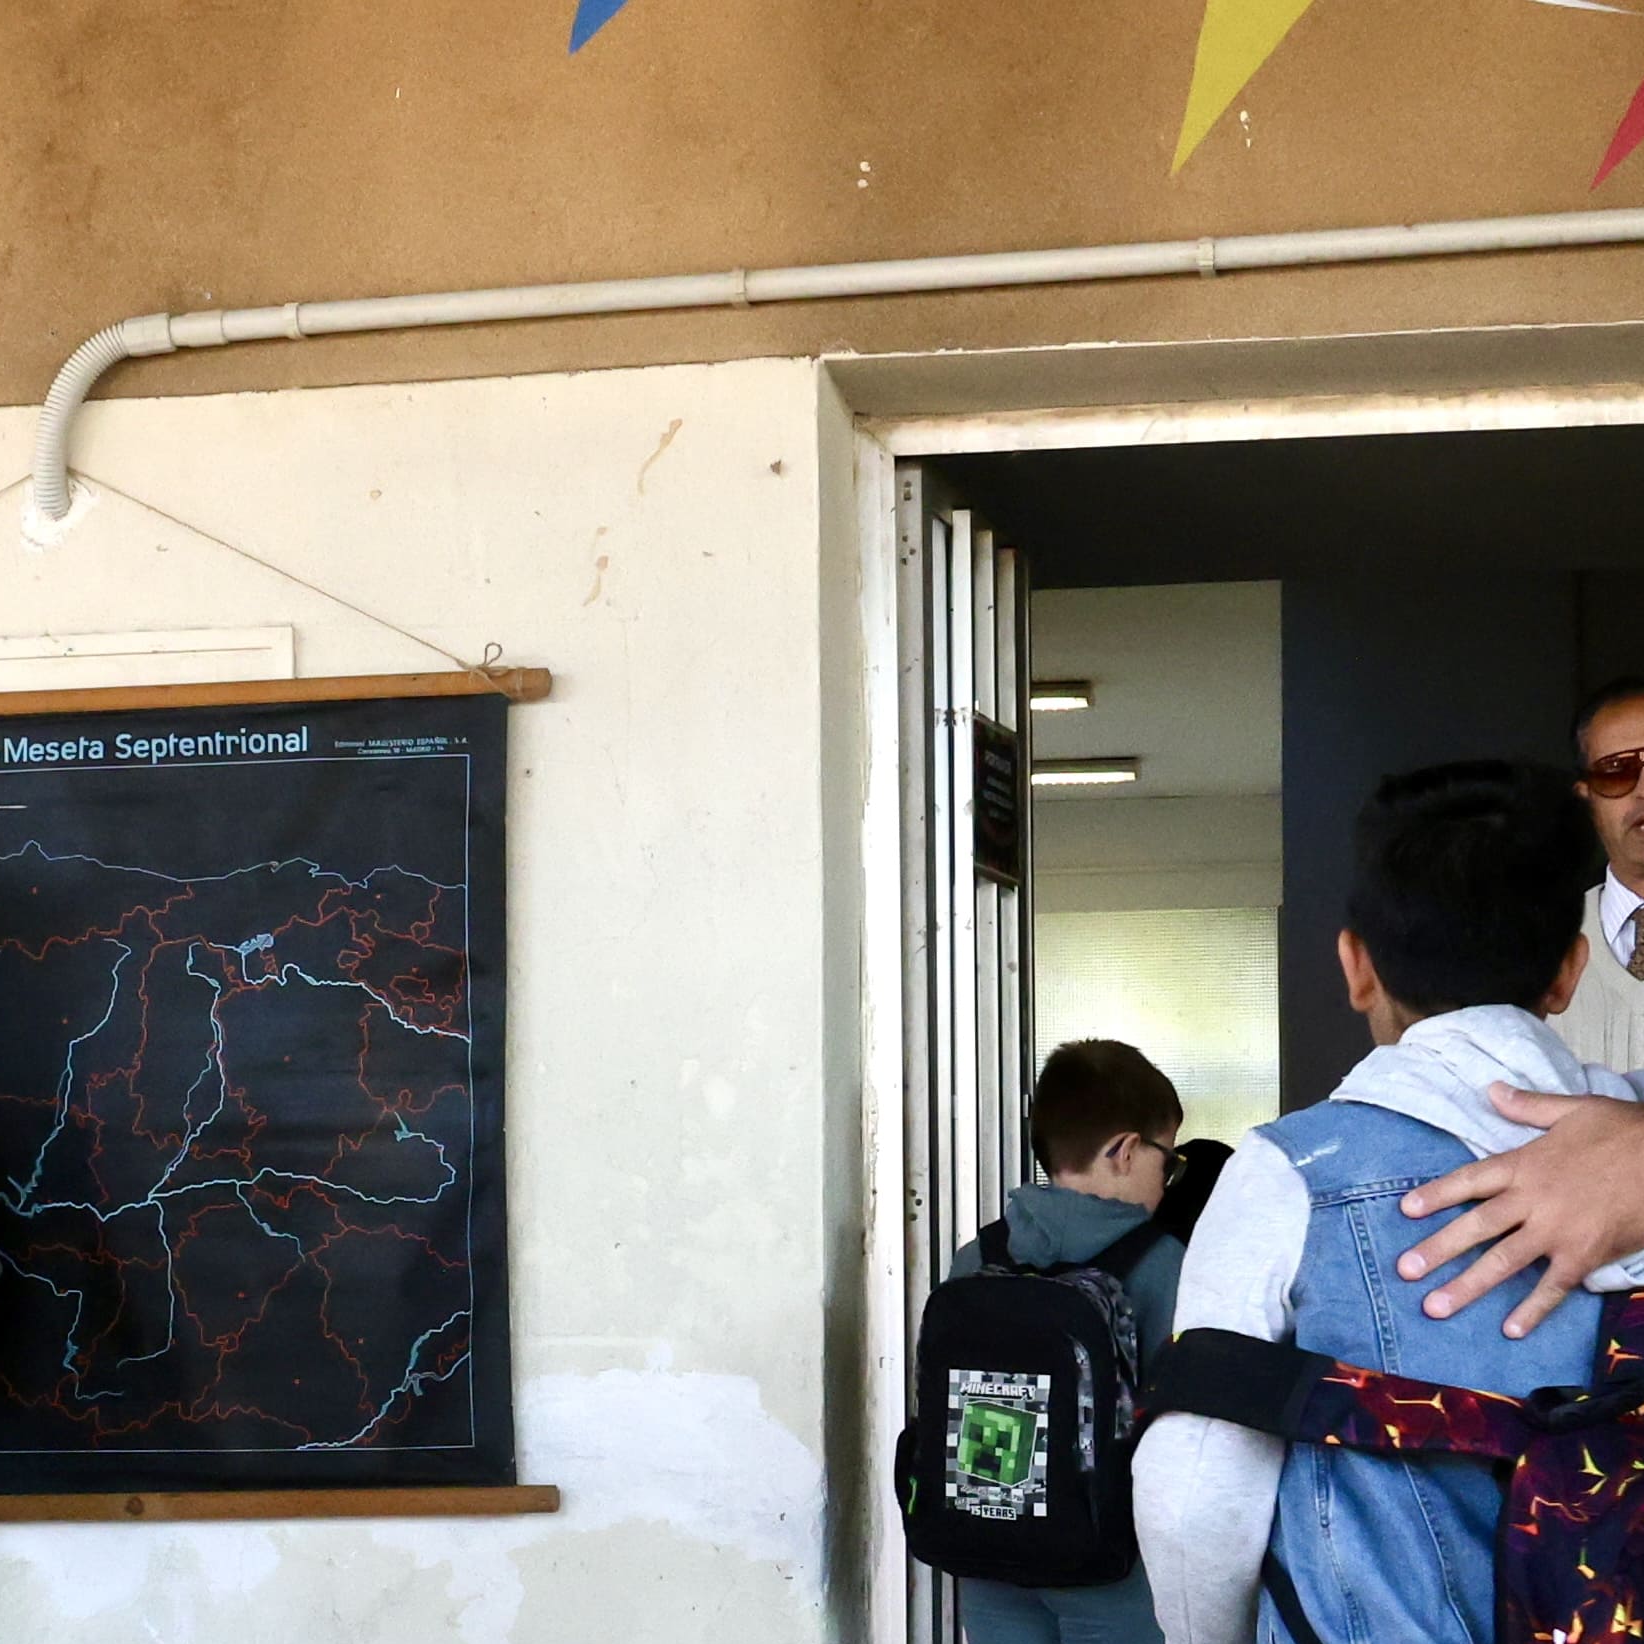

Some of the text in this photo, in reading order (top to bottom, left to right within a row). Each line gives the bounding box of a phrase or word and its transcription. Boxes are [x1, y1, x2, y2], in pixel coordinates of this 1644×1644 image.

[114, 726, 308, 764] Septentrional
[959, 1381, 1037, 1401] MINECRAFT
[983, 1506, 1016, 1519] YEARS
